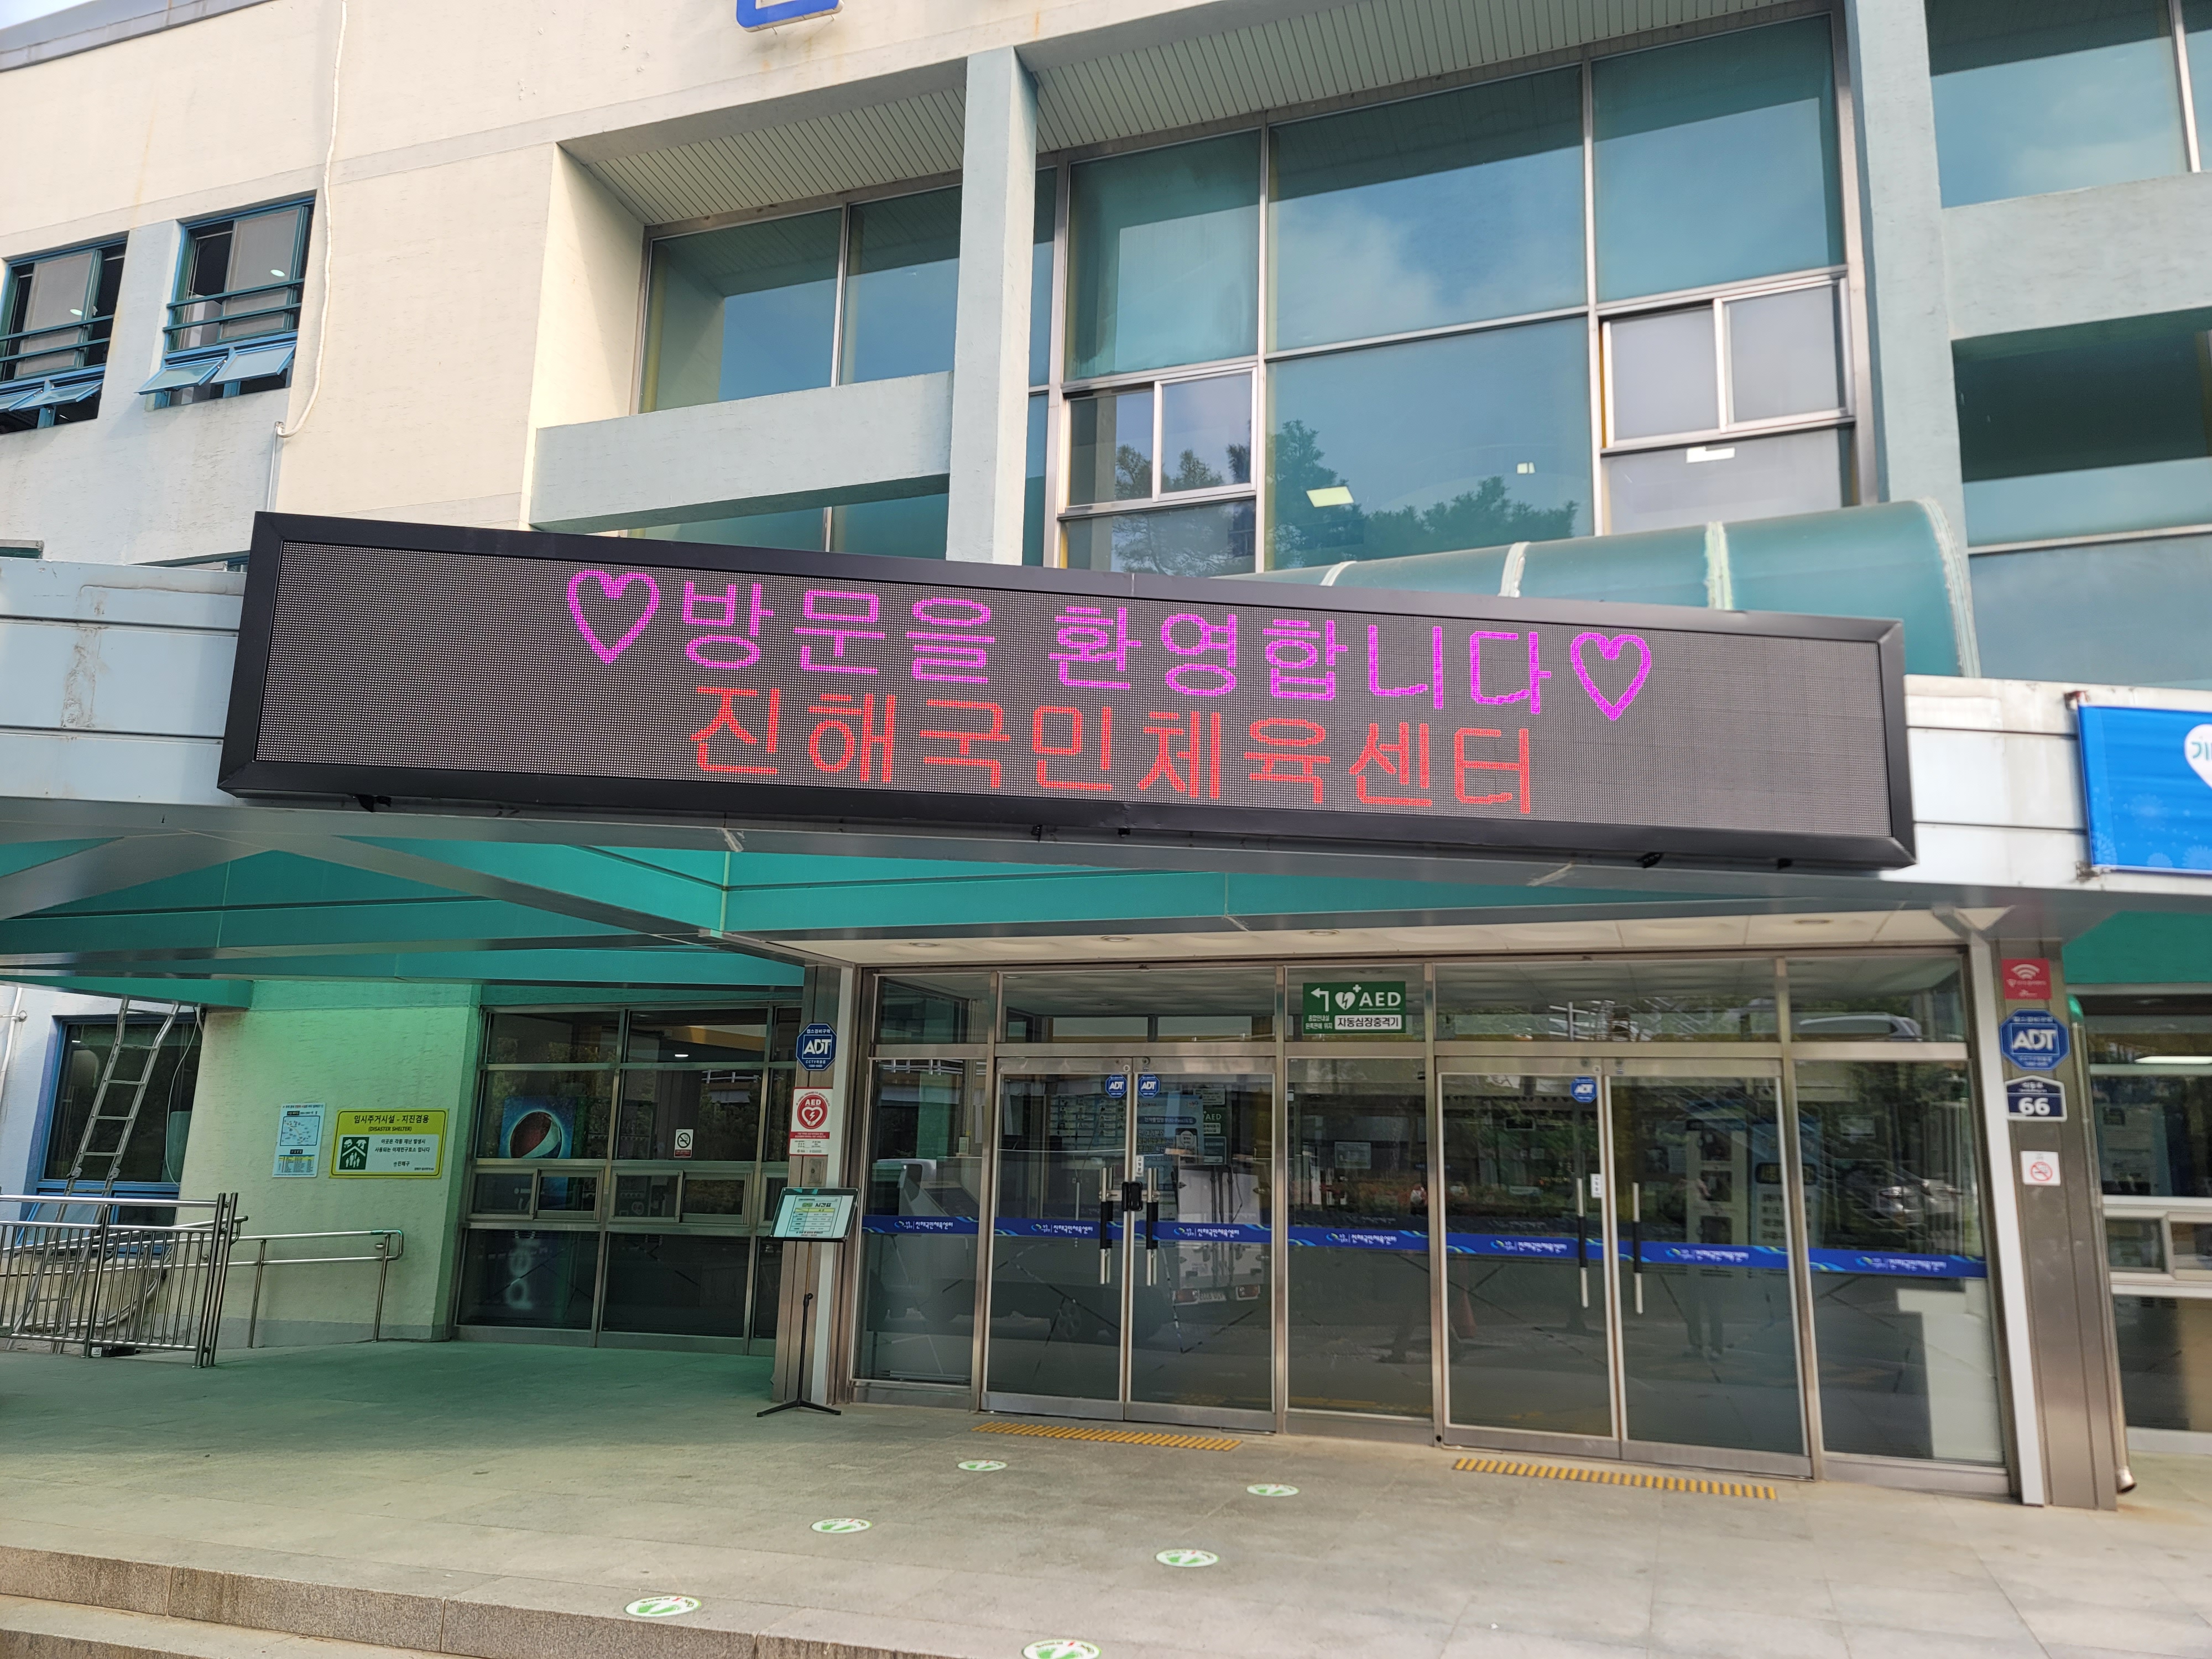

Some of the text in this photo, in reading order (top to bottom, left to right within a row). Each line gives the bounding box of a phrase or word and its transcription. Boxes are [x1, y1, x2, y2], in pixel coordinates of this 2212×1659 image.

[682, 581, 1552, 716] 방문을 환영합니다
[691, 686, 1532, 813] 진해국민체육센터
[1359, 992, 1401, 1006] AED
[1337, 1017, 1399, 1027] 자동심장충격기
[804, 1039, 832, 1055] ADT
[2012, 1029, 2057, 1051] ADT
[1109, 1081, 1124, 1090] ADT
[1141, 1081, 1156, 1090] ADT
[2018, 1097, 2051, 1115] 66
[354, 1115, 395, 1124] 임시주거시설
[402, 1115, 429, 1124] 지진겸용
[1053, 1225, 1093, 1234] 진해국민체육센터
